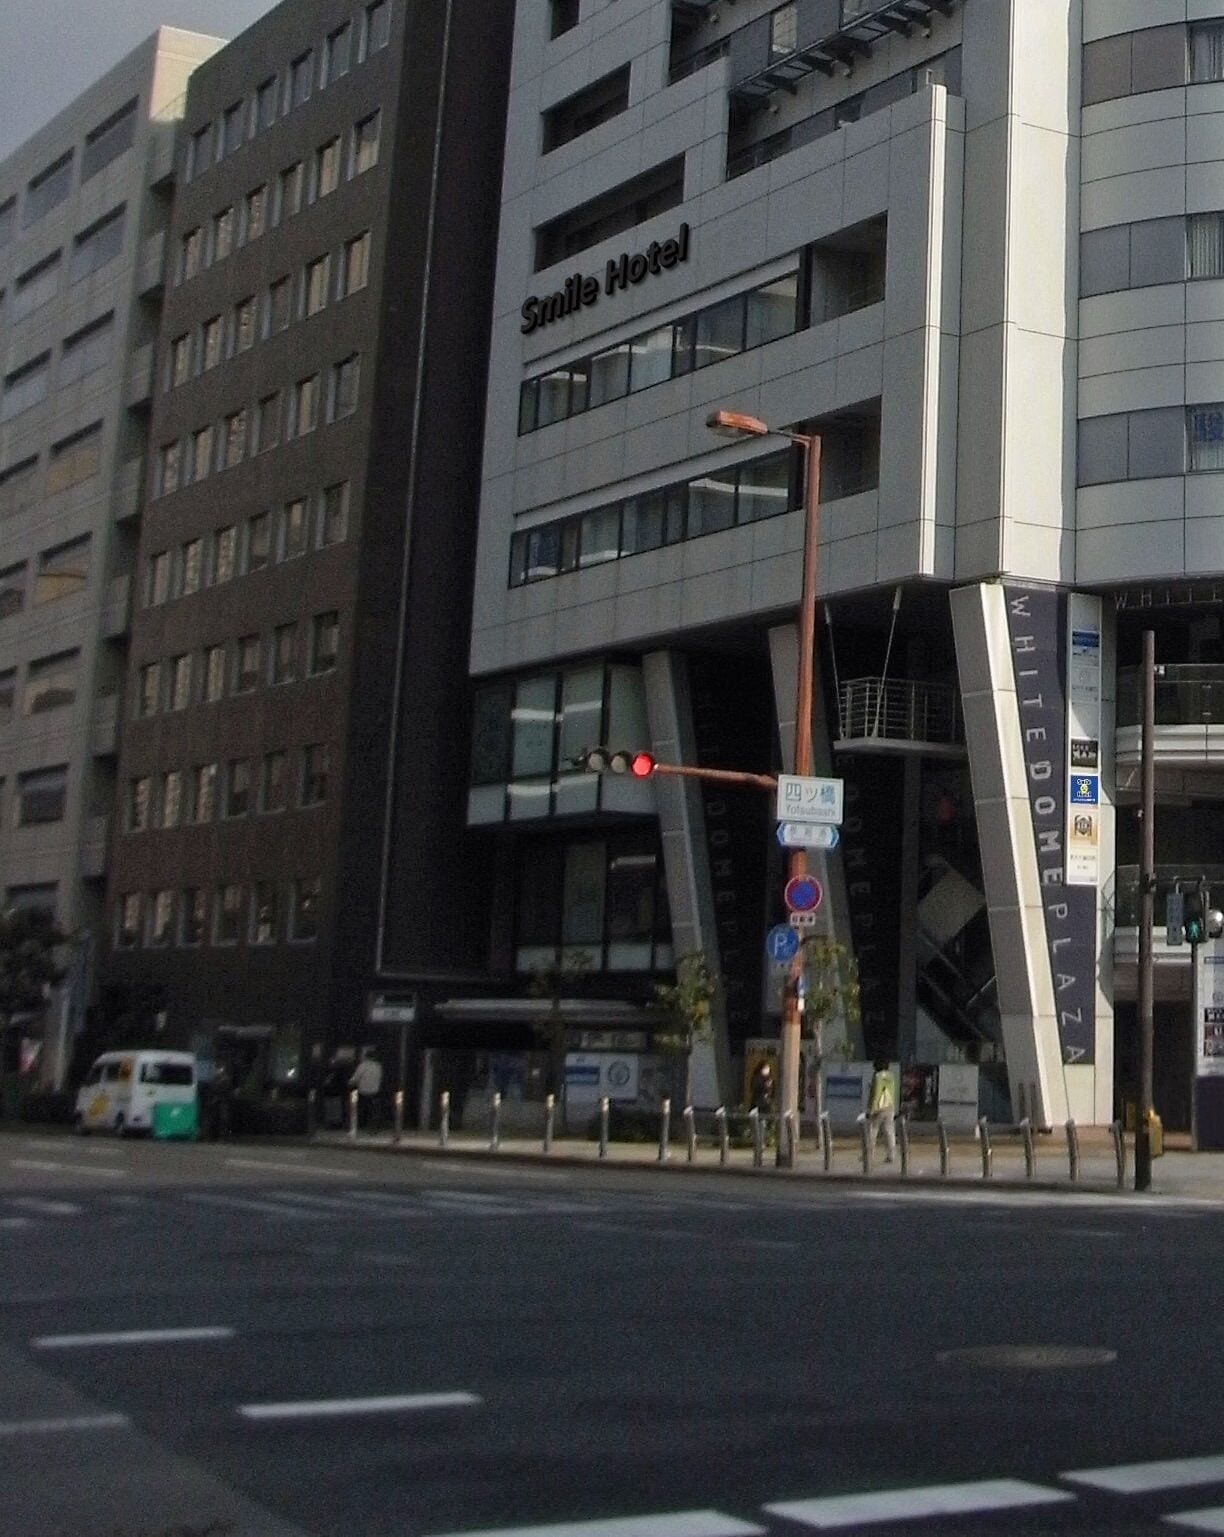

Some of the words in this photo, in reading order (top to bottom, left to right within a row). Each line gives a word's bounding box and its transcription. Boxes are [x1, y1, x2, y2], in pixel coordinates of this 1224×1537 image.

[520, 273, 599, 334] Smile
[605, 223, 689, 295] Hotel
[1010, 595, 1047, 742] WHITE
[1030, 760, 1063, 884] DOME
[1049, 903, 1086, 1063] PLAZA
